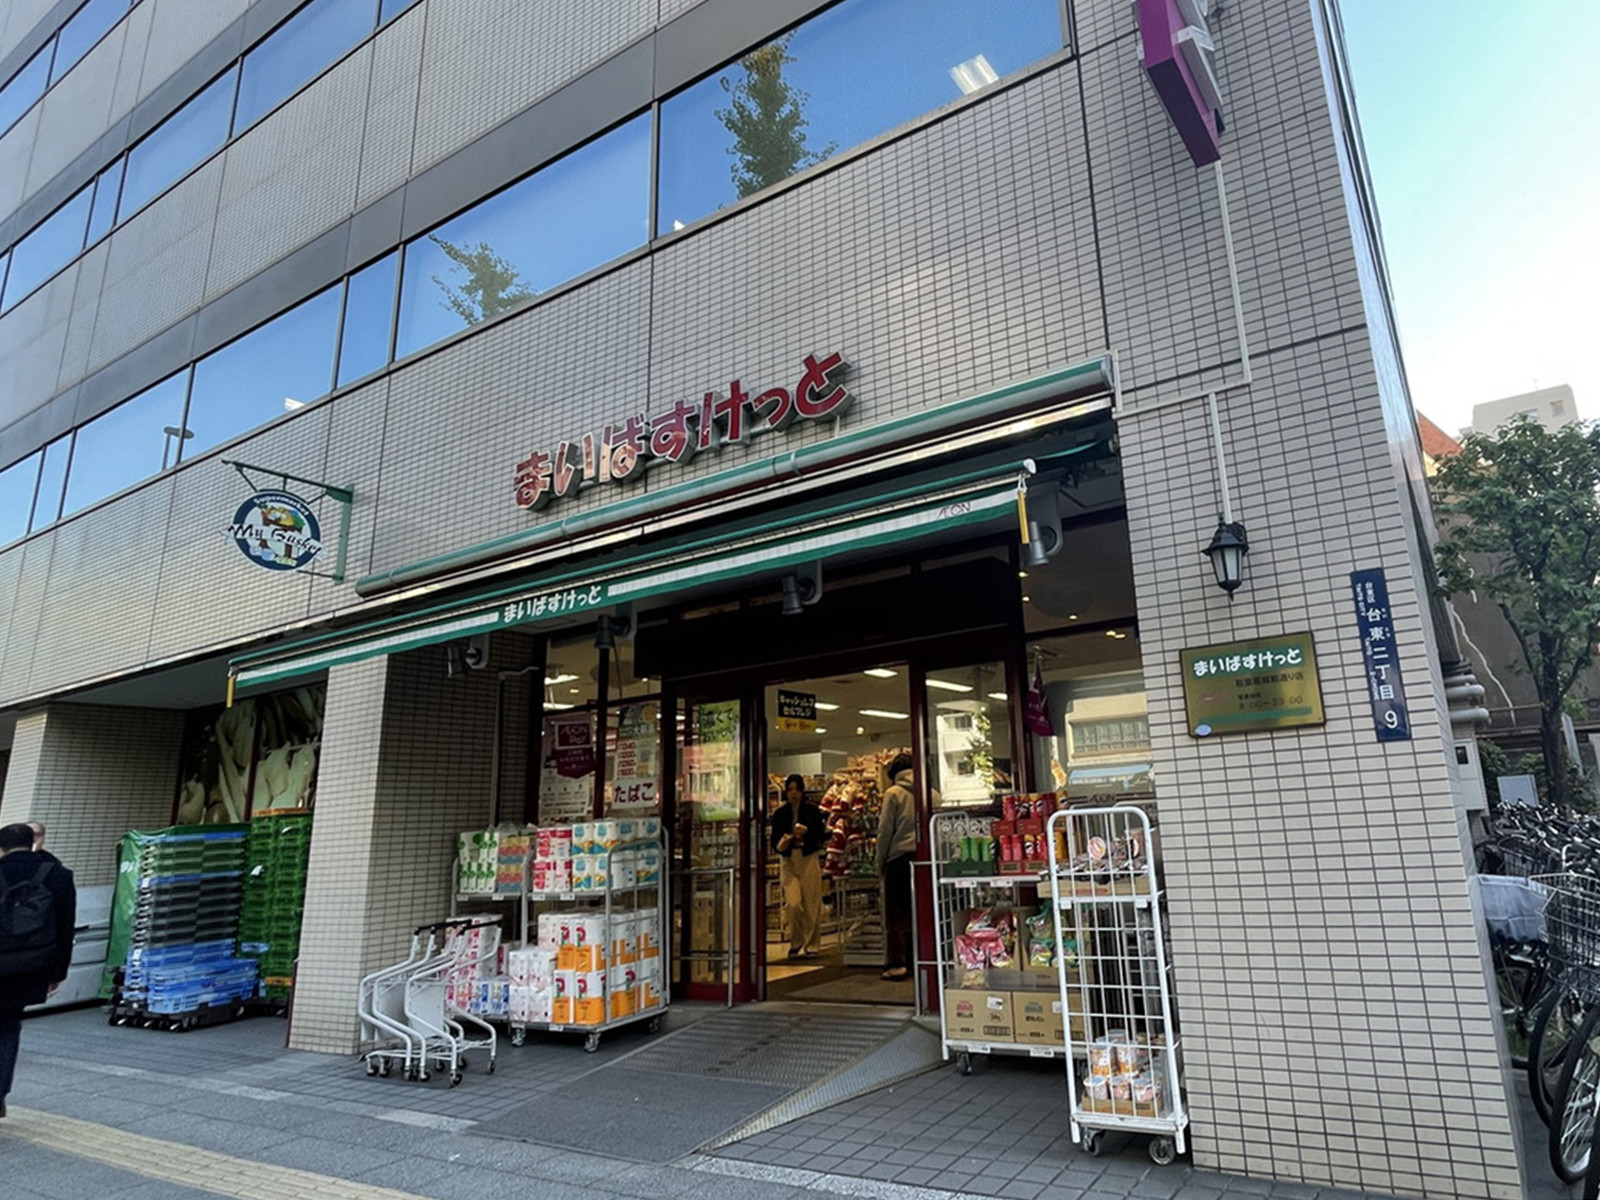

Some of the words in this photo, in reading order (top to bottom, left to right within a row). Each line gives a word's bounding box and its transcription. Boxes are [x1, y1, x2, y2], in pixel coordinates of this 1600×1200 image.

[513, 351, 848, 511] まいばすけっと
[228, 523, 263, 541] My
[503, 585, 602, 624] まいばすけっと
[1193, 648, 1303, 677] まいばすけっと
[1366, 607, 1395, 700] 台東二丁目
[1385, 709, 1399, 730] 9
[614, 782, 654, 803] たばこ
